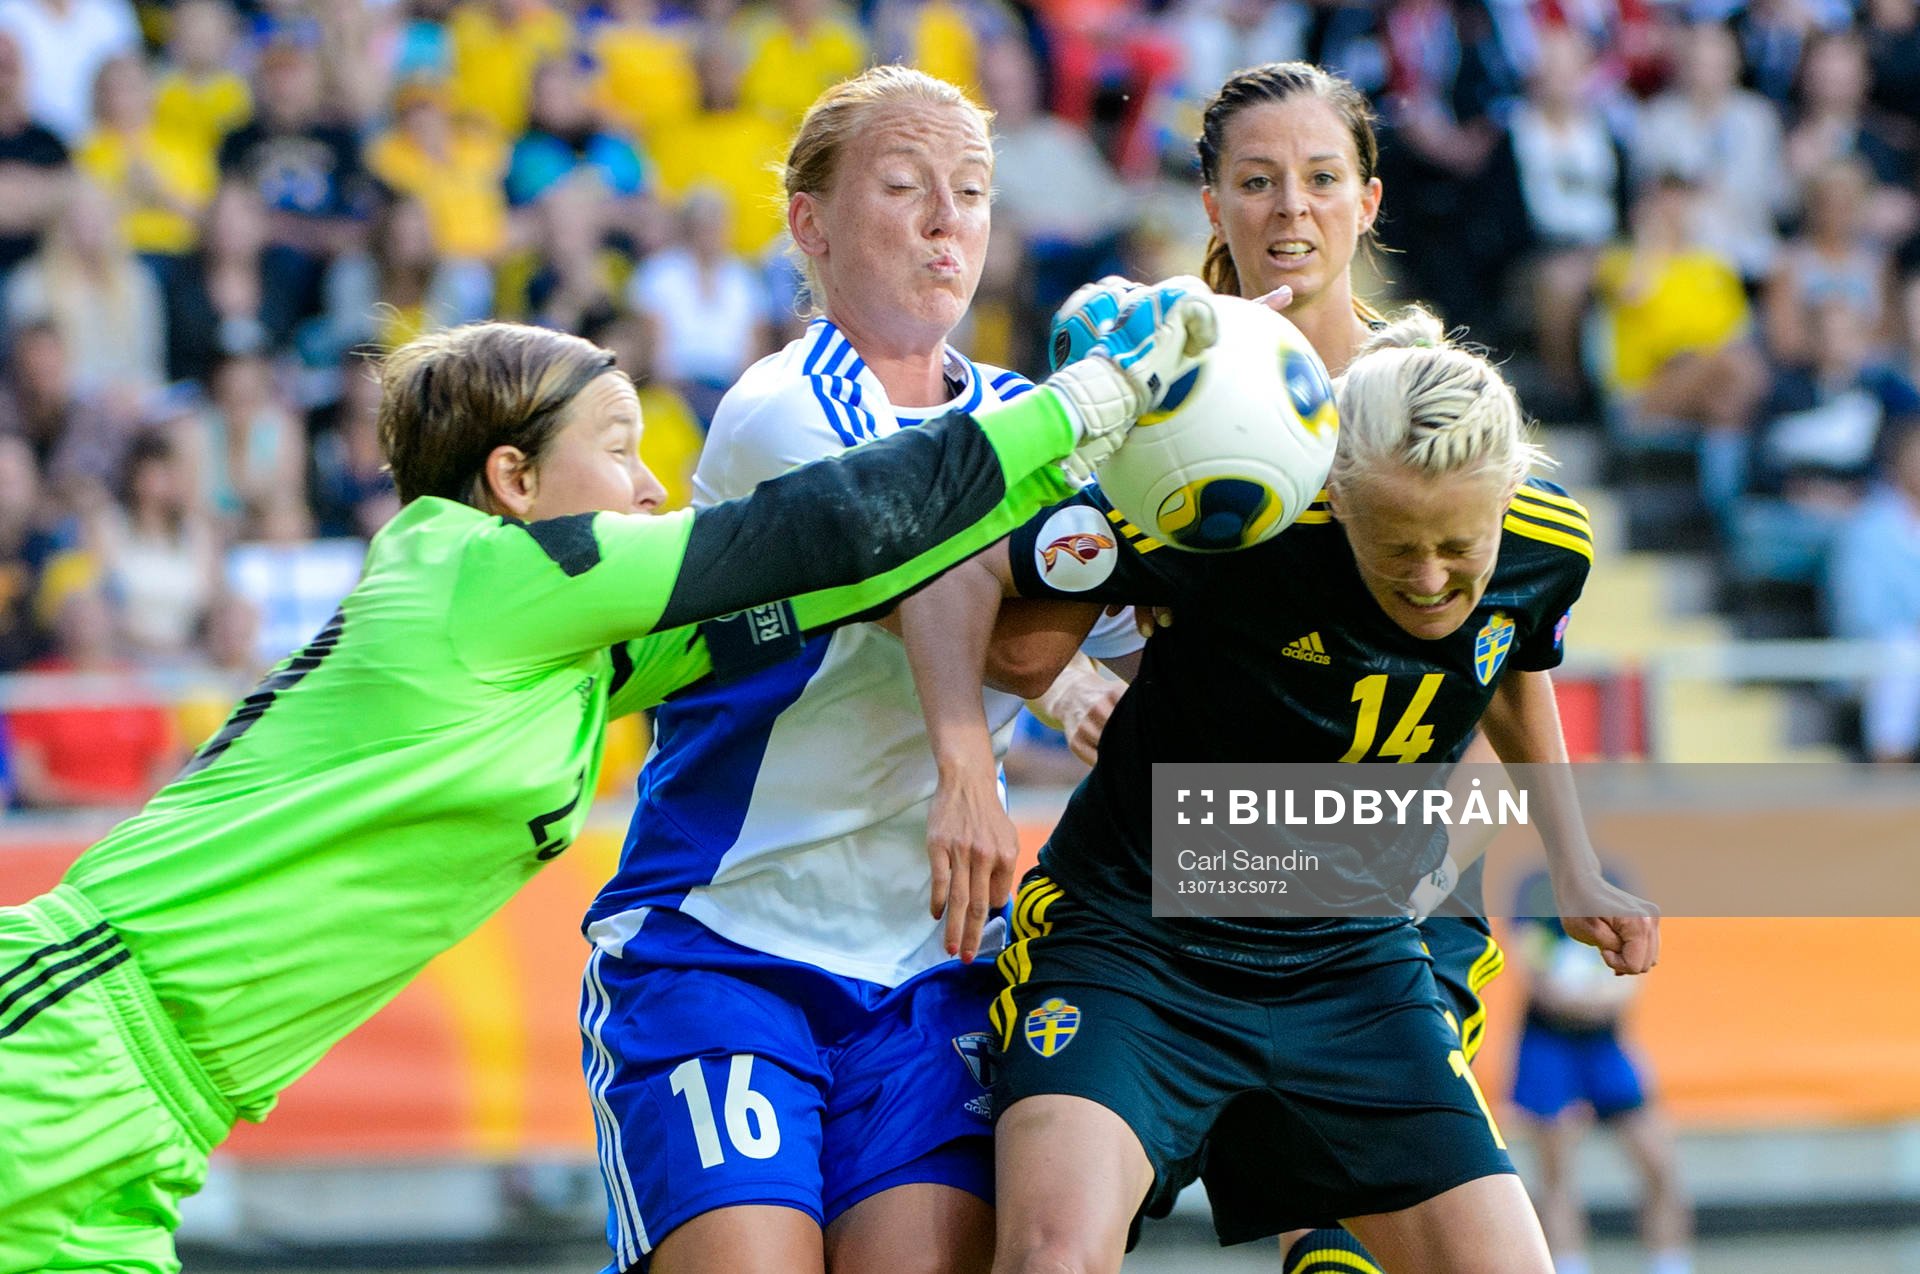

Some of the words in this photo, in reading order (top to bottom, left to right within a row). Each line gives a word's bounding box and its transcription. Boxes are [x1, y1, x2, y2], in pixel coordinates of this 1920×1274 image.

[1281, 646, 1331, 665] adidas
[1338, 673, 1445, 764] 14
[669, 1054, 781, 1169] 16
